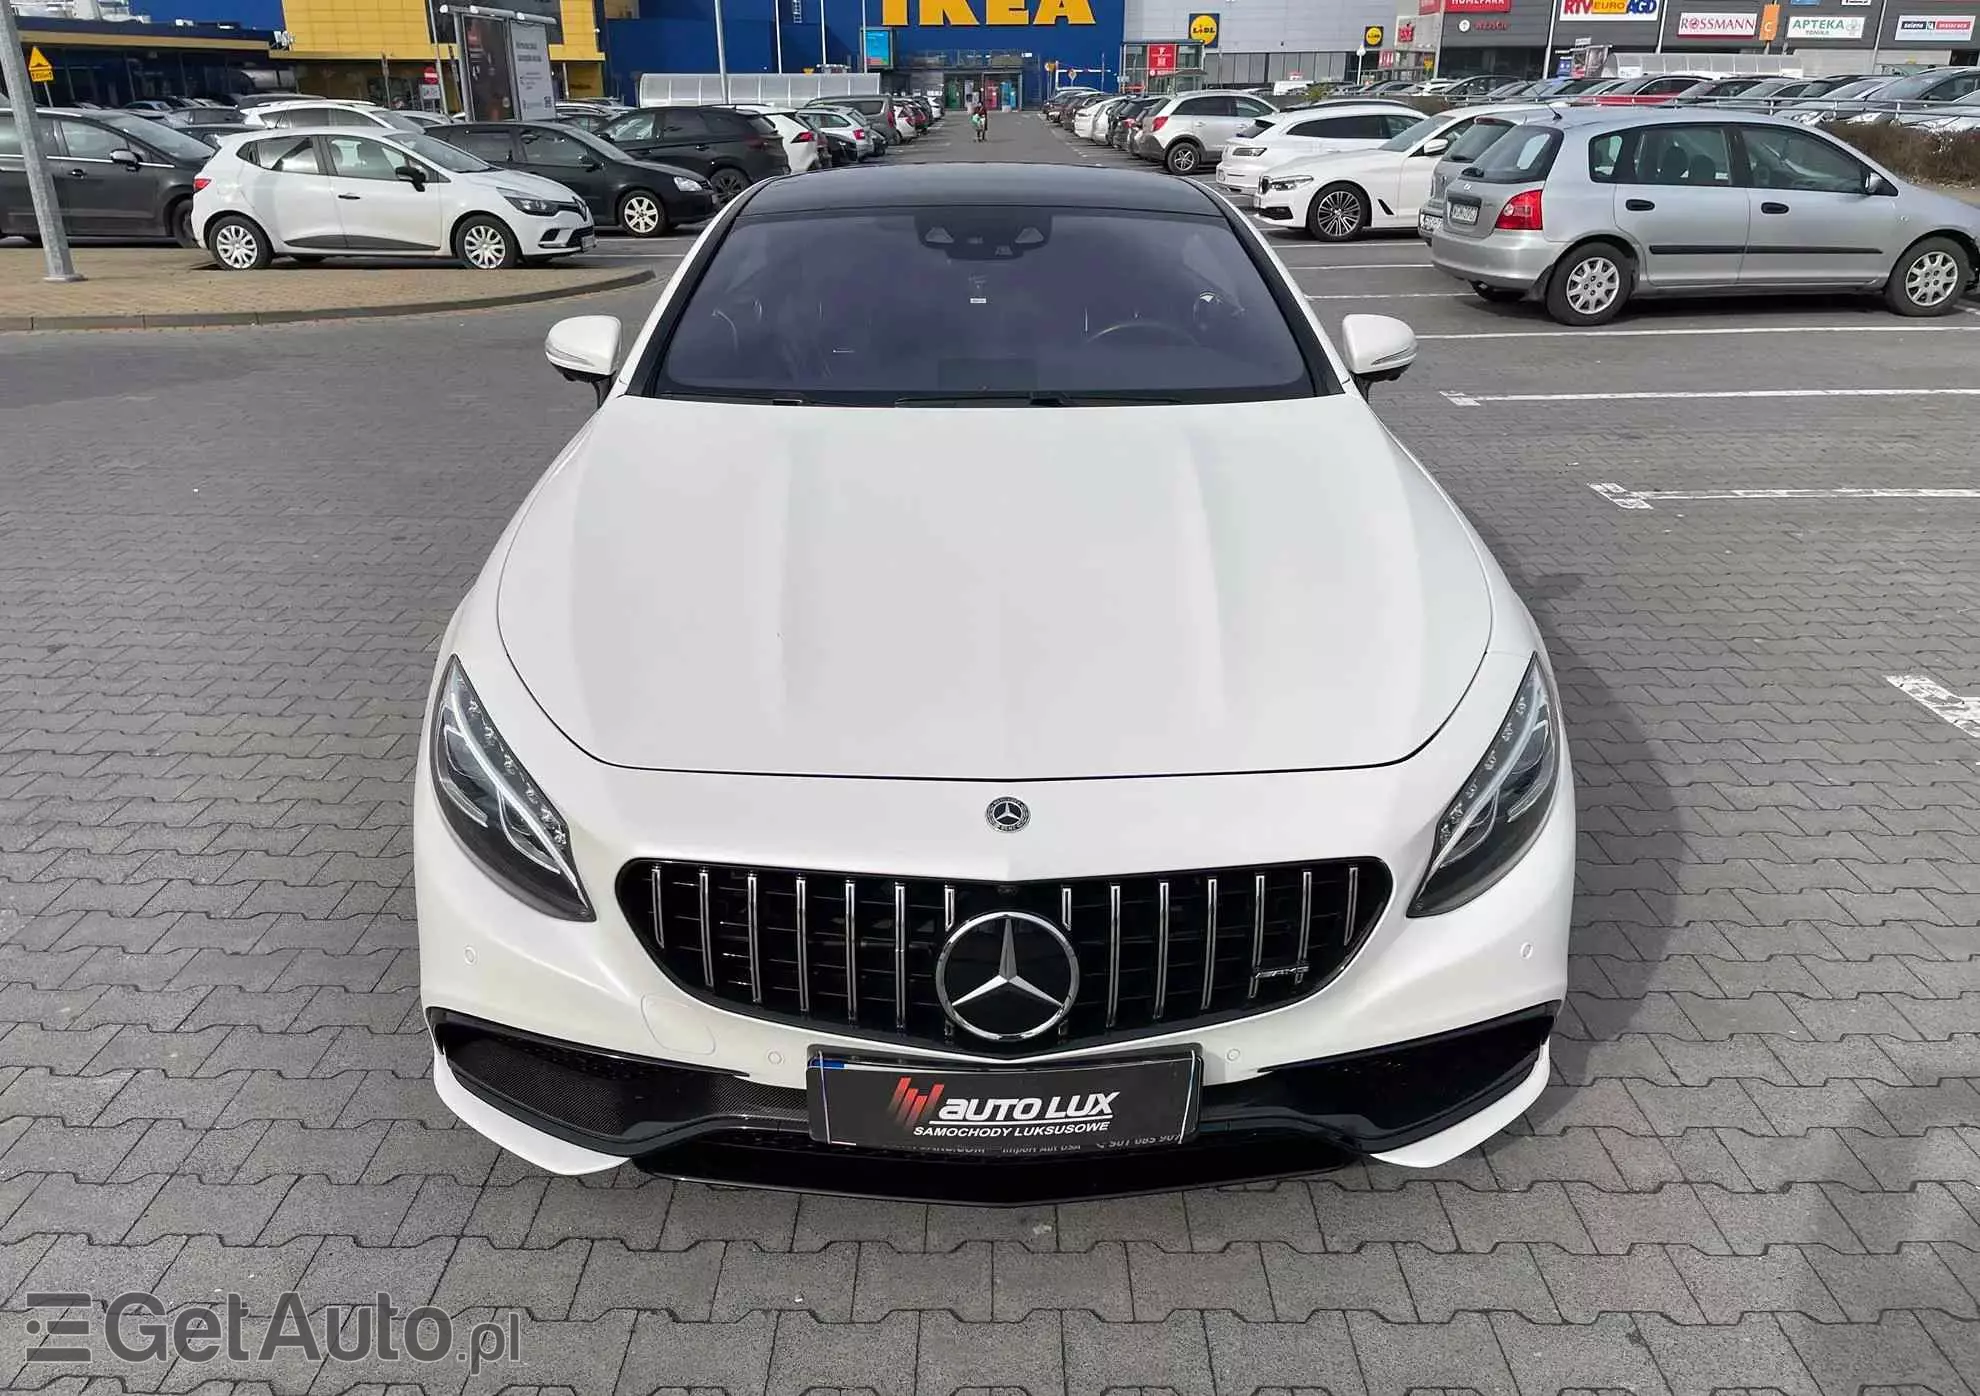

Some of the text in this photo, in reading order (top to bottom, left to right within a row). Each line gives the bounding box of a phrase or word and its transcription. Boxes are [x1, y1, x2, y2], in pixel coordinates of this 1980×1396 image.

[882, 0, 1097, 25] IKEA
[1563, 0, 1657, 14] RTV EURO AGD
[1680, 17, 1755, 30] ROSSMANN
[1792, 20, 1845, 30] APTEKA
[1043, 1091, 1120, 1118] LUX
[913, 1122, 1110, 1138] SAMOCHODY LUKSUSOWE
